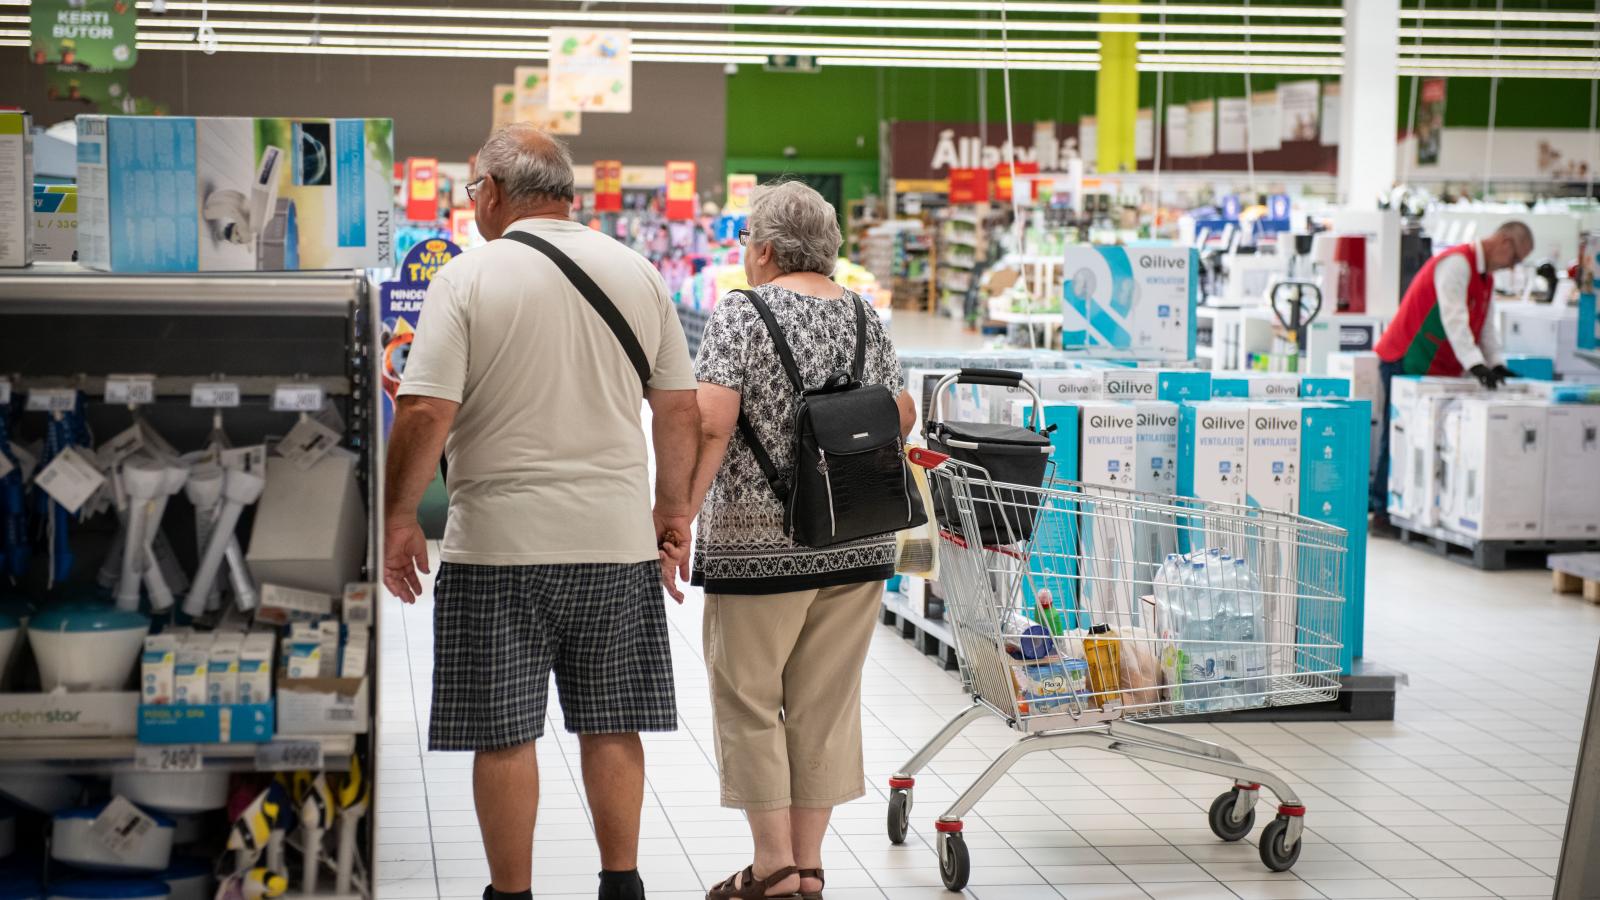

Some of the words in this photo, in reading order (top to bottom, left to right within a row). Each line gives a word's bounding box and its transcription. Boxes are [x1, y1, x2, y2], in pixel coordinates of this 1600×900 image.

[57, 10, 109, 25] KERTI
[377, 210, 390, 263] INTEX
[1139, 255, 1185, 269] Qilive
[390, 289, 427, 300] MINDE
[1058, 384, 1089, 394] Qilive
[1107, 381, 1153, 394] Qilive
[1265, 384, 1296, 395] Qilive
[1090, 415, 1134, 429] Qilive
[1137, 413, 1177, 427] Qilive
[1201, 416, 1246, 430] Qilive
[1255, 417, 1298, 430] Qilive
[1088, 435, 1133, 445] VENTILATEUR
[1137, 433, 1177, 443] ENTILATEUR
[1199, 436, 1245, 446] VENTILATEUR
[1253, 437, 1298, 447] VENTILATEUR
